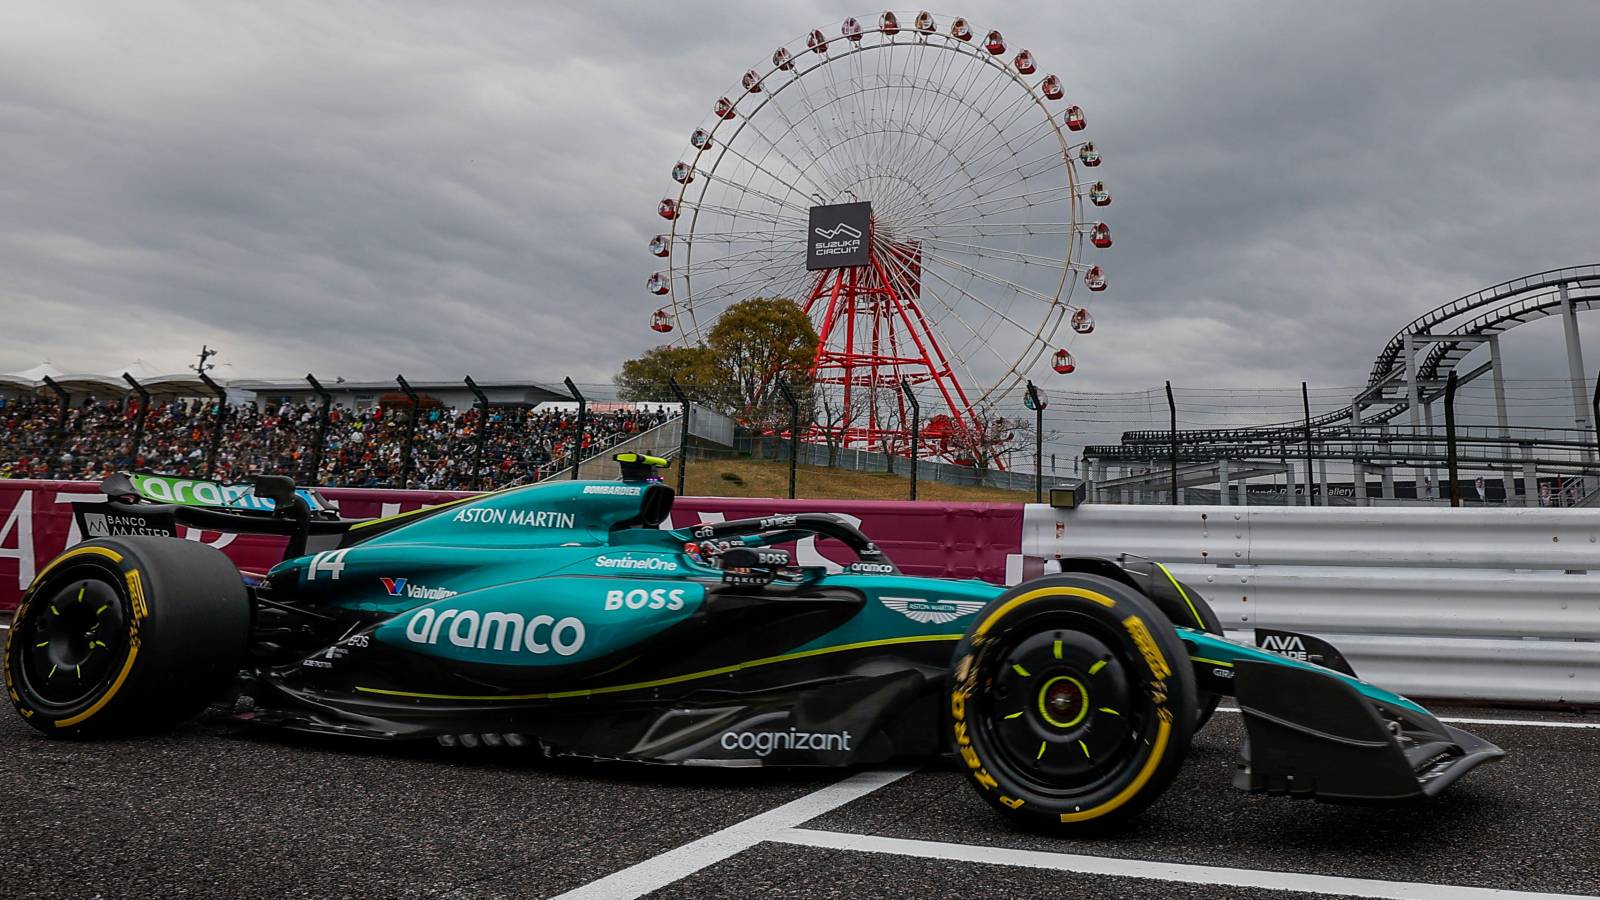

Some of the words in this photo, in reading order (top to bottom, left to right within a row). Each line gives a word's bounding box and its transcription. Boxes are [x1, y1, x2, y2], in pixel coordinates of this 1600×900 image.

[815, 240, 860, 249] SUZUKA
[815, 247, 859, 256] CIRCUIT
[583, 486, 640, 496] BOMBARDIER
[1280, 488, 1321, 496] RCIG
[1326, 487, 1355, 497] allery
[107, 515, 147, 527] BANCO
[453, 508, 505, 525] ASTON
[508, 510, 574, 529] MARTIN
[694, 526, 714, 538] citi
[595, 555, 677, 572] SentinelOne
[758, 552, 788, 564] BOSS
[307, 549, 348, 580] 14
[851, 563, 893, 573] aramco
[604, 589, 685, 611] BOSS
[406, 608, 586, 656] aramco
[1261, 635, 1306, 651] AVA
[720, 727, 852, 756] cognizant
